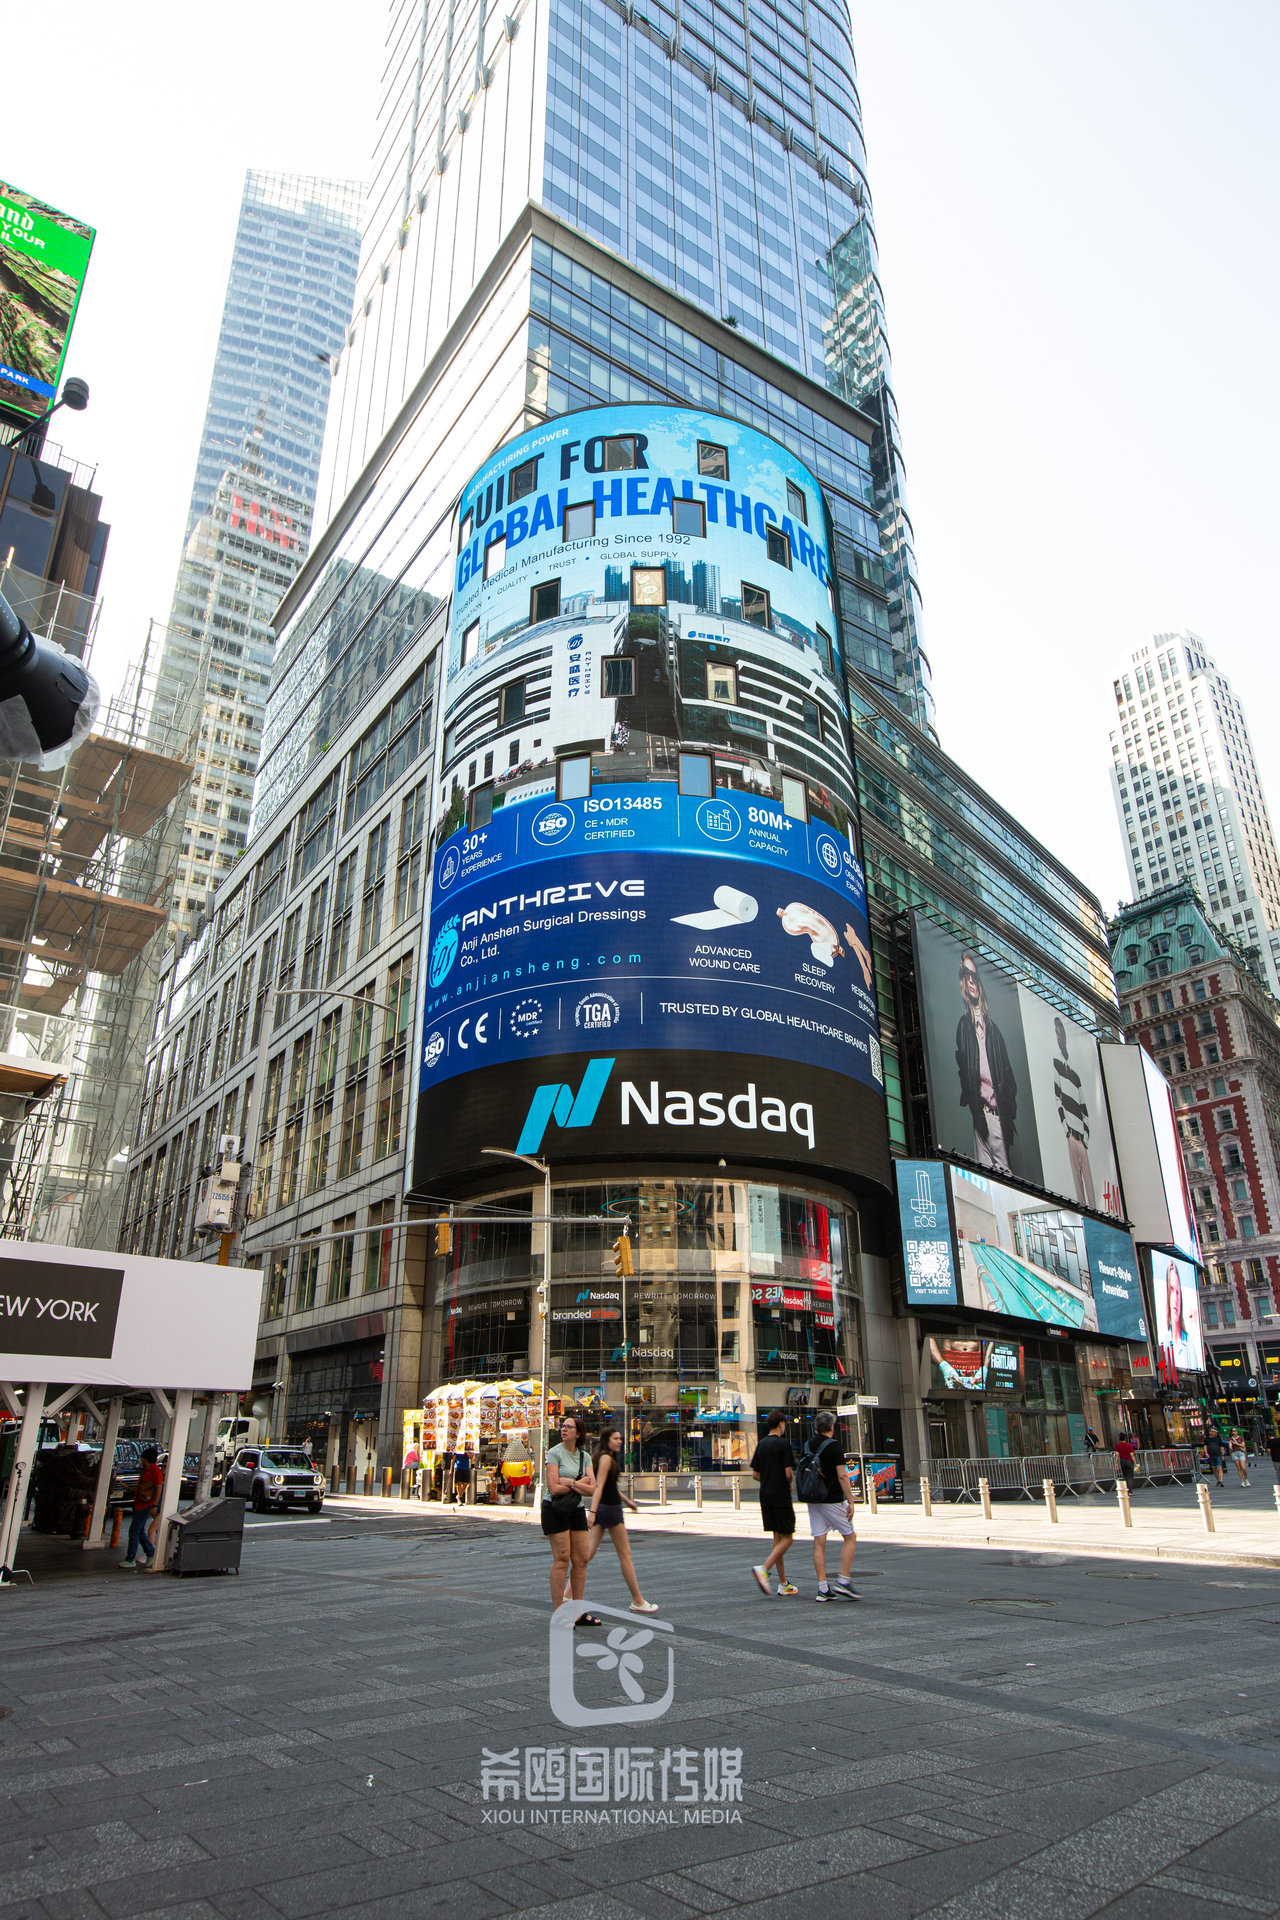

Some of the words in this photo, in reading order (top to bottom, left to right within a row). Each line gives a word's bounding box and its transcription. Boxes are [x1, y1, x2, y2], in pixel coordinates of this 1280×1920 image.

[2, 220, 46, 249] YOUR
[0, 367, 29, 385] PARK
[467, 443, 531, 503] MANUFACTURING
[531, 428, 569, 449] POWER
[456, 586, 480, 619] Trusted
[481, 562, 518, 592] Medical
[521, 537, 609, 568] Manufacturing
[614, 534, 653, 545] Since
[658, 533, 692, 546] 1992
[497, 575, 528, 595] QUALITY
[548, 558, 577, 571] TRUST
[600, 551, 638, 560] GLOBAL
[640, 550, 679, 558] SUPPLY
[568, 653, 582, 698] 安盛医疗
[583, 797, 663, 813] ISO13485
[538, 816, 568, 833] ISO
[584, 820, 598, 829] CE
[605, 817, 629, 826] MDR
[748, 806, 793, 831] 80M+
[462, 832, 488, 854] 30+
[584, 829, 636, 841] CERTIFIED
[748, 828, 782, 843] ANNUAL
[461, 850, 483, 865] YEARS
[749, 839, 790, 857] CAPACITY
[461, 852, 503, 878] EXPERIENCE
[461, 879, 646, 932] ANTHRIVE
[461, 936, 479, 953] Anji
[480, 923, 520, 945] Anshen
[523, 912, 574, 932] Surgical
[578, 908, 647, 923] Dressings
[460, 953, 479, 968] Co.,
[481, 944, 500, 960] Ltd.
[695, 945, 752, 959] ADVANCED
[689, 957, 731, 970] WOUND
[732, 961, 761, 974] CARE
[802, 962, 827, 977] SLEEP
[794, 973, 836, 994] RECOVERY
[517, 1011, 538, 1023] MDR
[582, 1003, 612, 1023] TGA
[457, 1012, 489, 1050] CE
[584, 1020, 612, 1029] CERTIFIED
[659, 1002, 719, 1015] TRUSTED
[722, 1006, 739, 1017] BY
[741, 1007, 785, 1025] GLOBAL
[786, 1015, 844, 1041] HEALTHCARE
[844, 1032, 869, 1054] BRANDS
[424, 1036, 445, 1062] ISO
[621, 1081, 816, 1150] Nasdaq
[1098, 1260, 1133, 1283] Resort-Style
[589, 1291, 620, 1302] Nasdaq
[671, 1292, 717, 1301] TOMORROW
[1102, 1280, 1130, 1300] Amenities
[34, 1297, 100, 1322] YORK
[489, 1298, 523, 1308] TOMORROW
[781, 1296, 804, 1307] Nasdaq
[552, 1307, 618, 1321] brandedcities
[631, 1346, 674, 1360] Nasdaq
[990, 1353, 1018, 1371] FIGHTLAND
